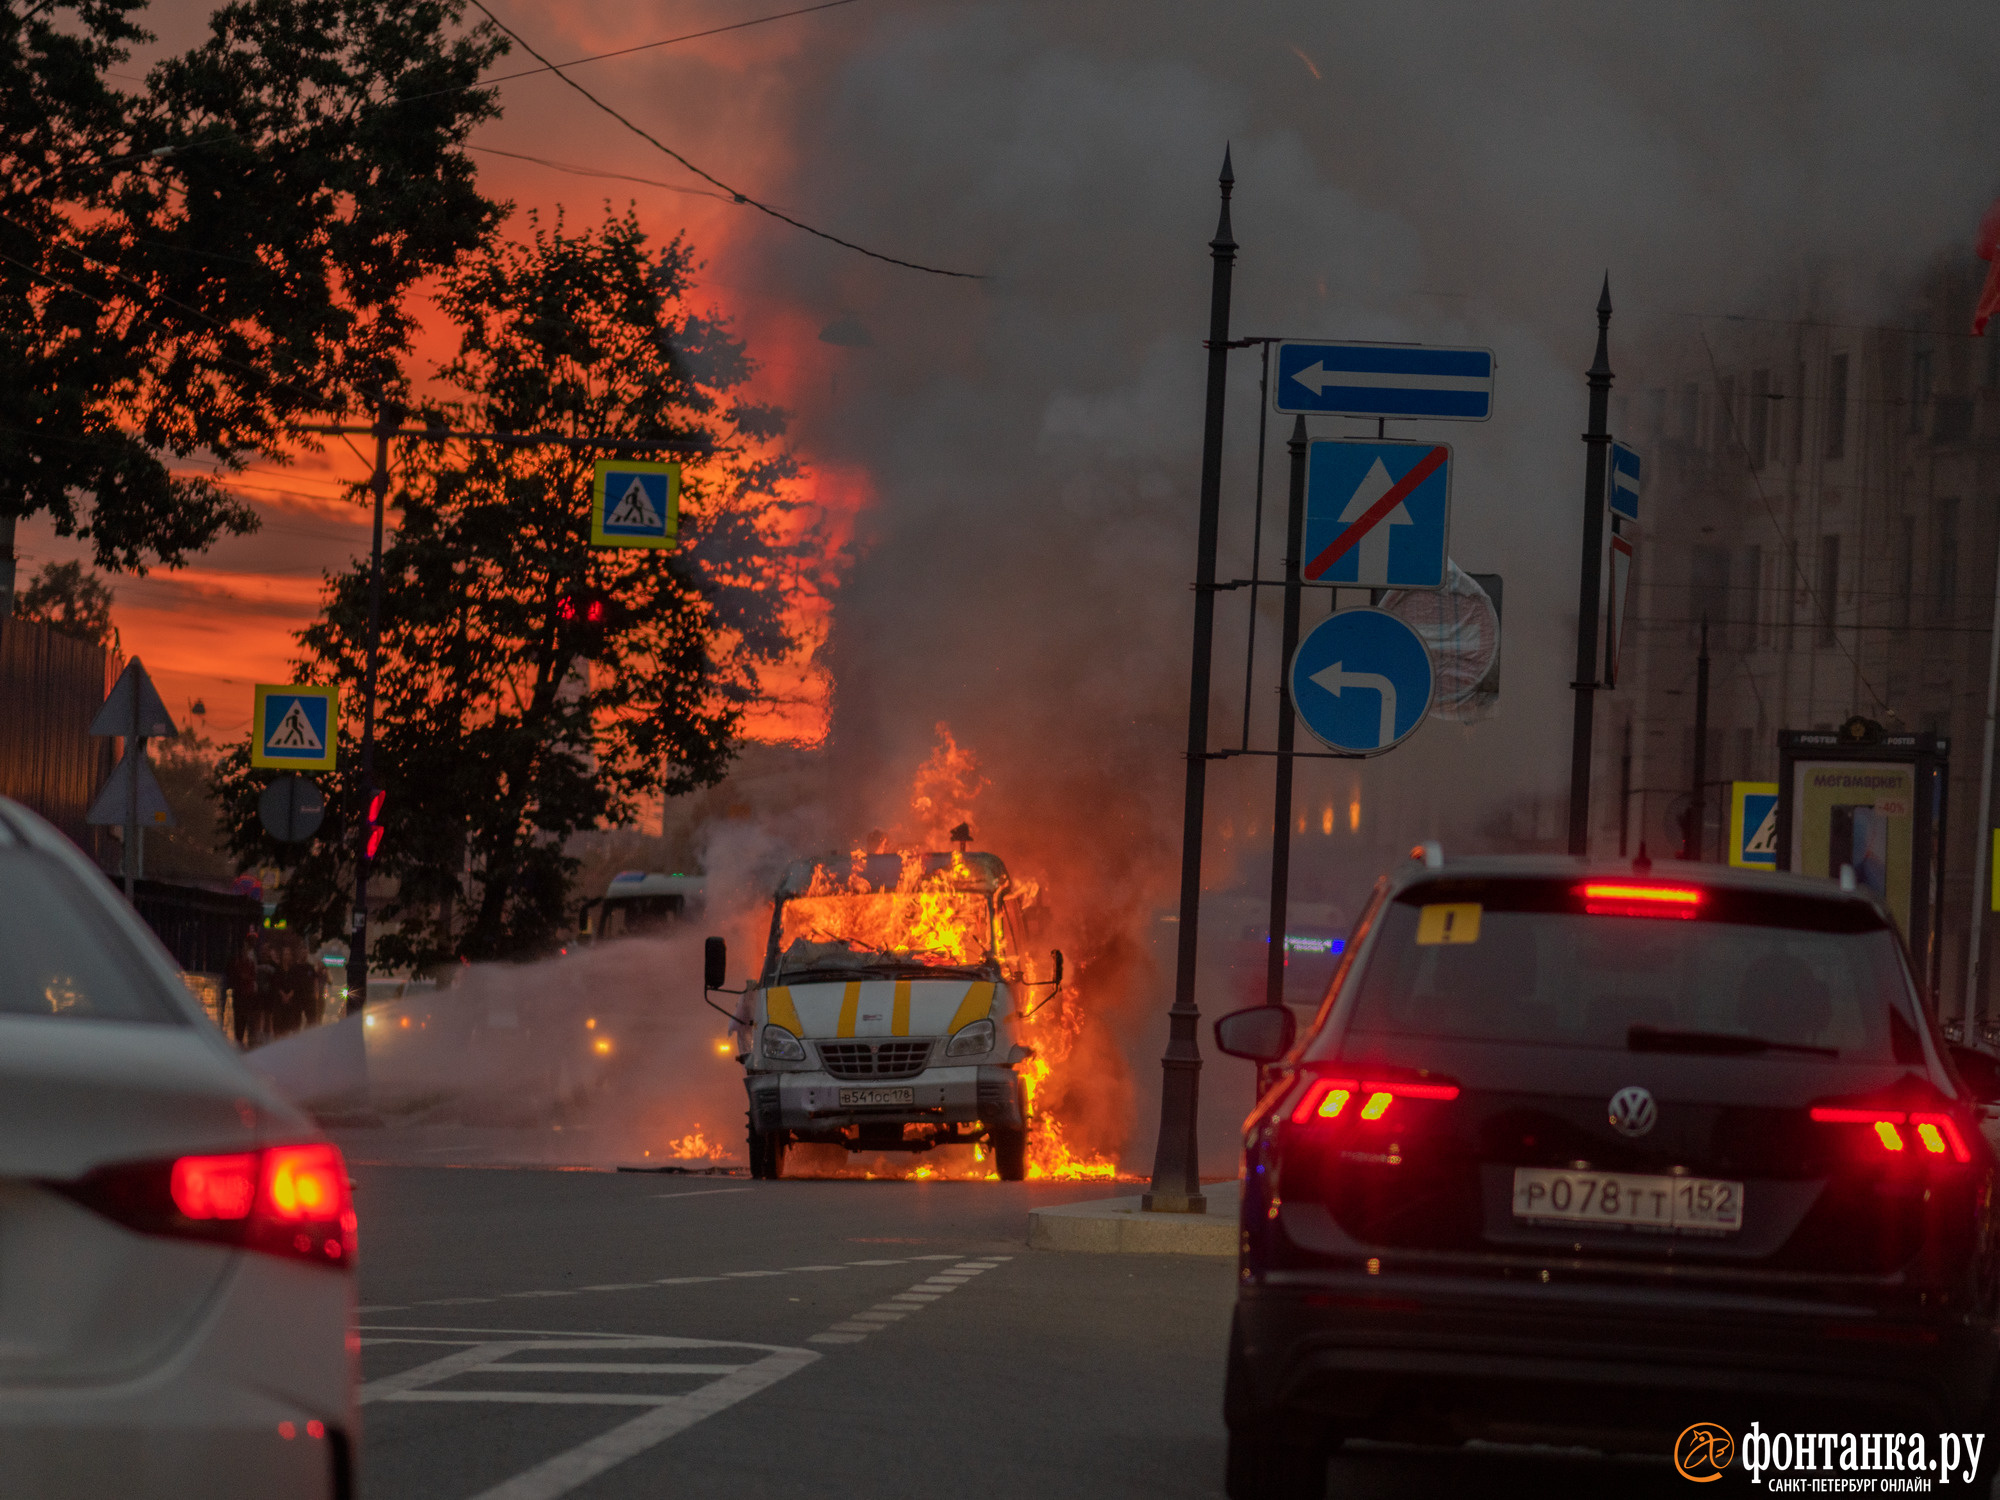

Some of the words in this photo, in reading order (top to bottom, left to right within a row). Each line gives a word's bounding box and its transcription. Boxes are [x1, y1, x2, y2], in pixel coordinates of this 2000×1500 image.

[1800, 736, 1837, 745] POSTER
[1887, 737, 1916, 745] POSTER
[1813, 775, 1903, 789] мегамаркет
[892, 1089, 910, 1099] 178
[1527, 1178, 1667, 1218] Р078ТТ
[1679, 1183, 1733, 1213] 152
